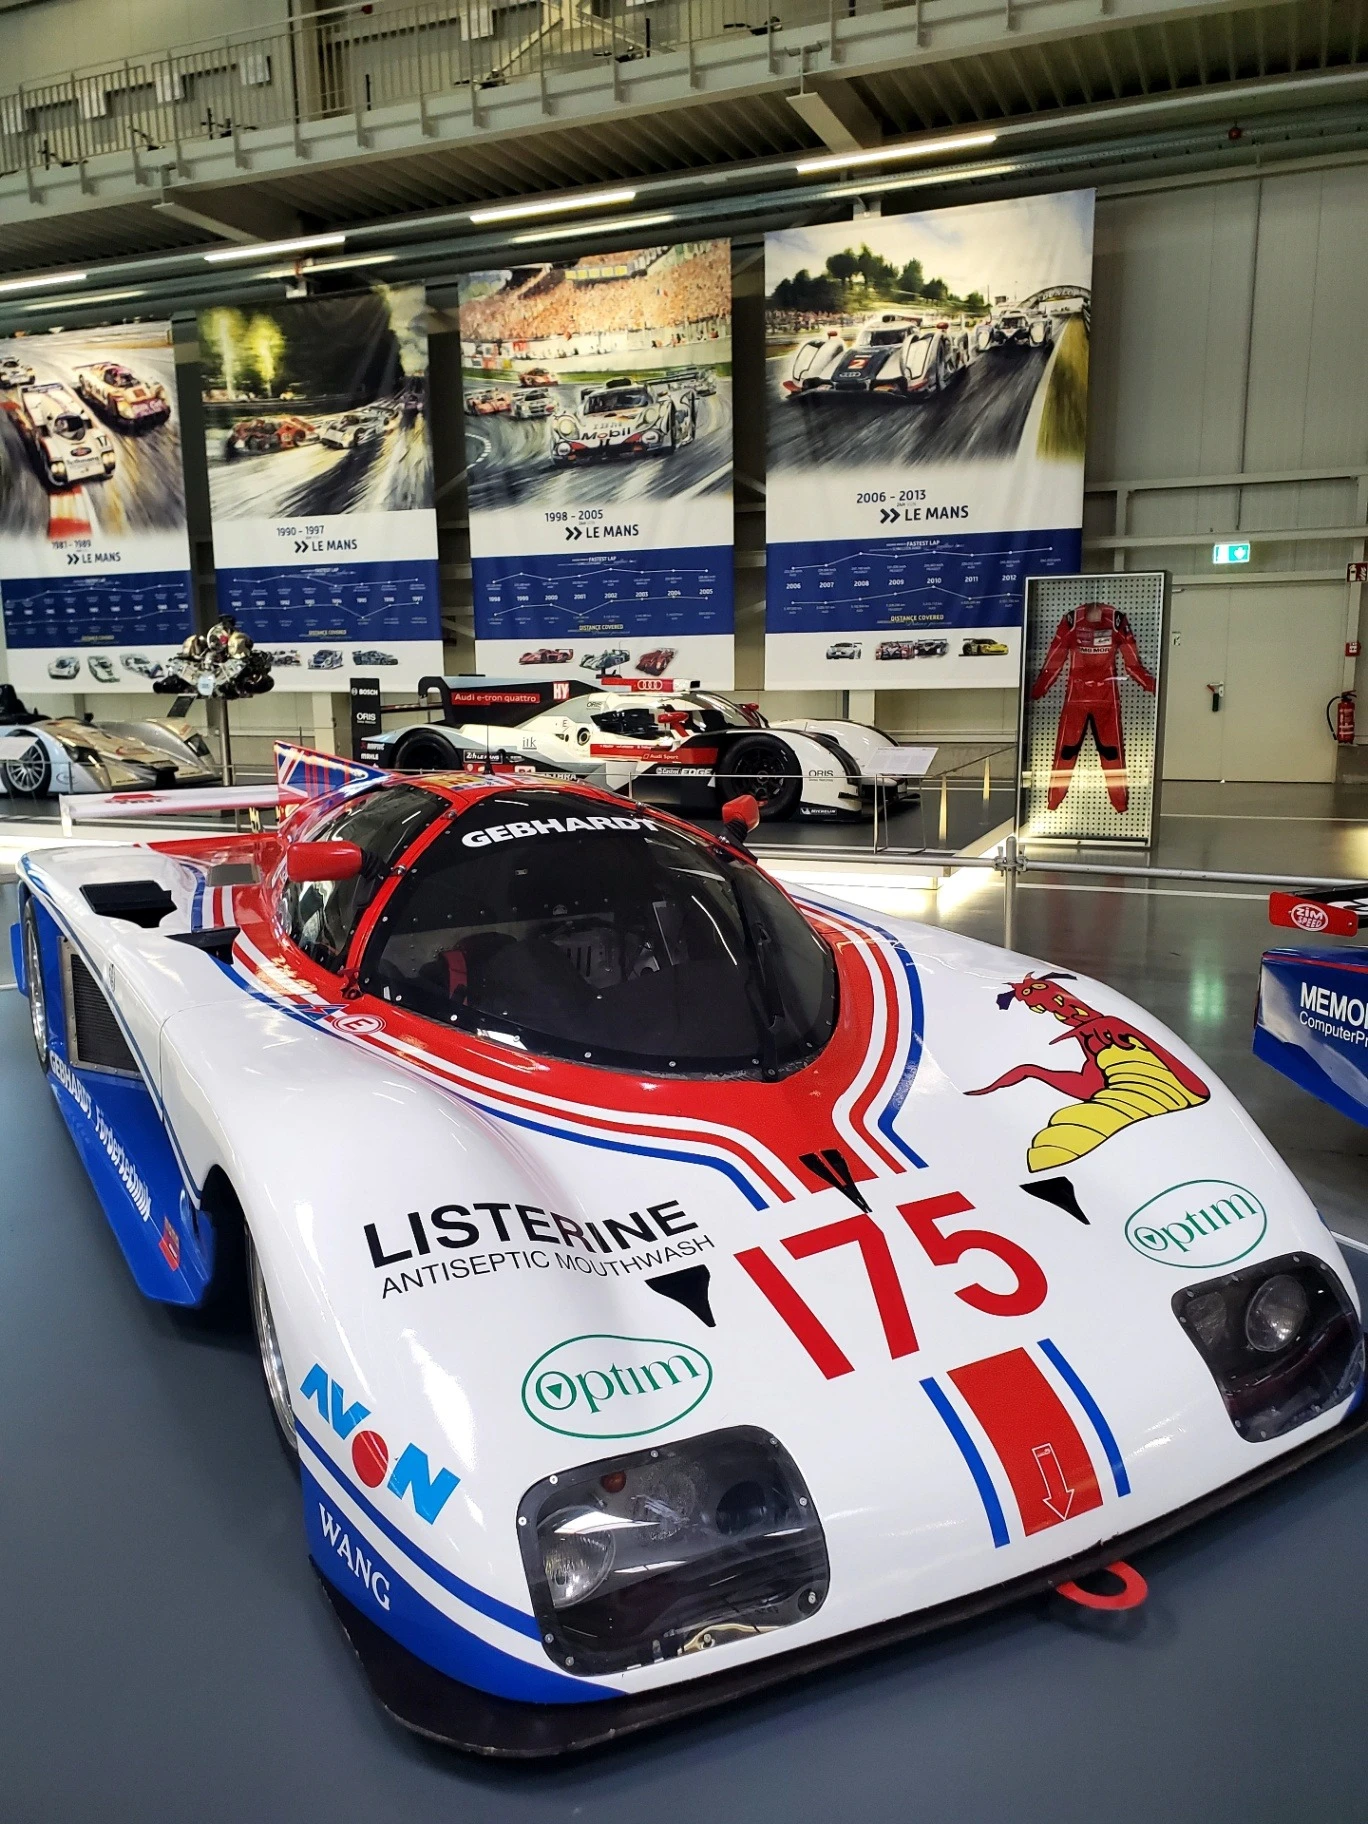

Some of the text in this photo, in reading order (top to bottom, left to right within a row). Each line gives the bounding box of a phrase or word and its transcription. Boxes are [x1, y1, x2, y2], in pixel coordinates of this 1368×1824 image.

[582, 427, 631, 440] Mobil
[856, 492, 886, 504] 2006
[899, 489, 926, 501] 2013
[545, 512, 568, 522] 1998
[578, 509, 603, 520] 2005
[904, 505, 969, 521] LE MANS
[277, 527, 297, 537] 1990
[305, 525, 325, 535] 1997
[586, 524, 639, 539] LE MANS
[311, 539, 358, 552] LE MANS
[82, 552, 121, 564] LE MANS
[455, 693, 537, 704] Audi e-tron quattro
[553, 683, 569, 699] HY
[356, 712, 376, 721] ORIS
[664, 754, 679, 762] Sport
[681, 768, 713, 776] EDGE
[808, 769, 834, 777] ORIS
[461, 816, 659, 848] GEBHARDT
[1298, 916, 1322, 928] SPEED
[1300, 982, 1368, 1030] MEMO
[50, 1050, 92, 1120] GEBHARDT
[1133, 1192, 1258, 1253] Optim
[363, 1199, 699, 1269] LISTERINE
[382, 1234, 715, 1299] ANTISEPTIC MOUTHWASH
[733, 1190, 1048, 1381] 175
[535, 1353, 701, 1414] Optim
[300, 1363, 462, 1526] AVON
[318, 1502, 391, 1611] WANG
